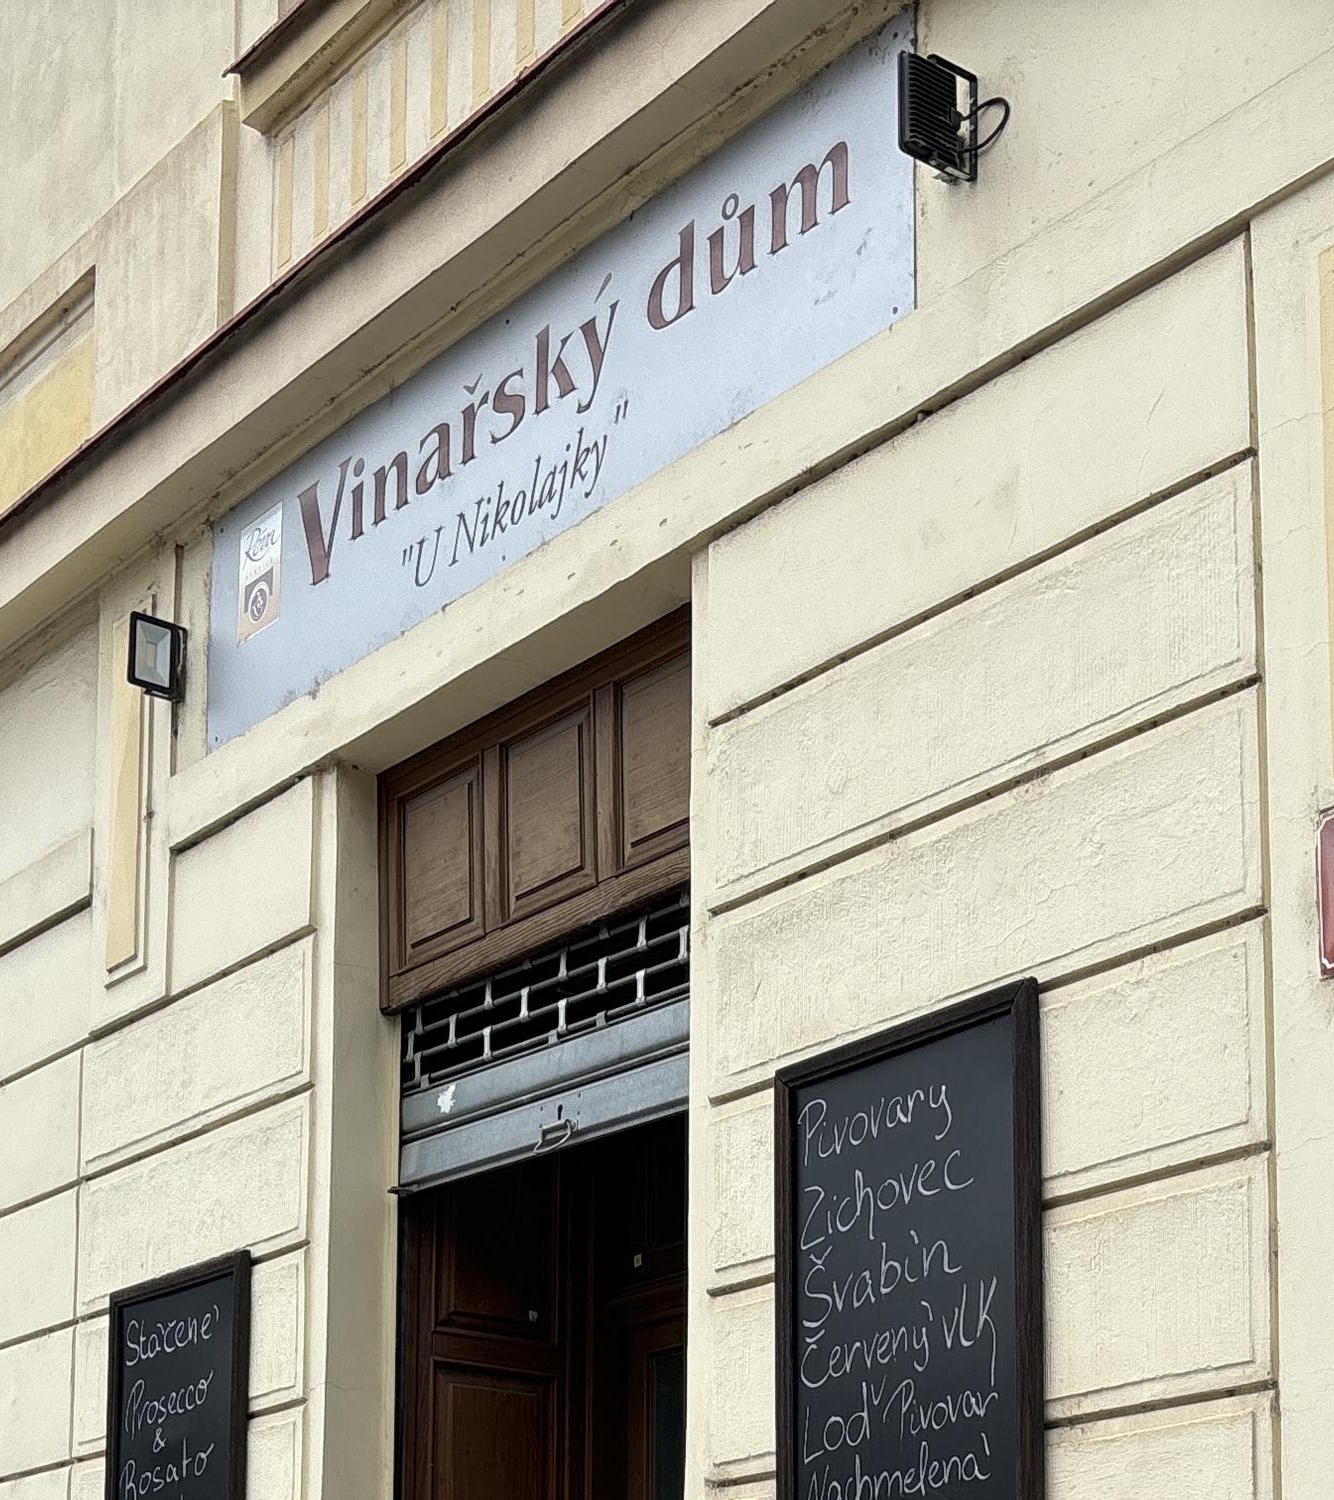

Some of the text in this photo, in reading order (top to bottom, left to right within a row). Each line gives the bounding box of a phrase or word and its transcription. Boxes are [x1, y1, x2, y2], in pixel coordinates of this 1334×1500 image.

[297, 140, 851, 586] Vinařský dům
[797, 1084, 953, 1167] Pivovary
[800, 1149, 974, 1251] Zichovec
[800, 1300, 934, 1388] Červený
[124, 1368, 214, 1441] Prosecco
[152, 1427, 167, 1454] &
[882, 1378, 999, 1441] Pivovar
